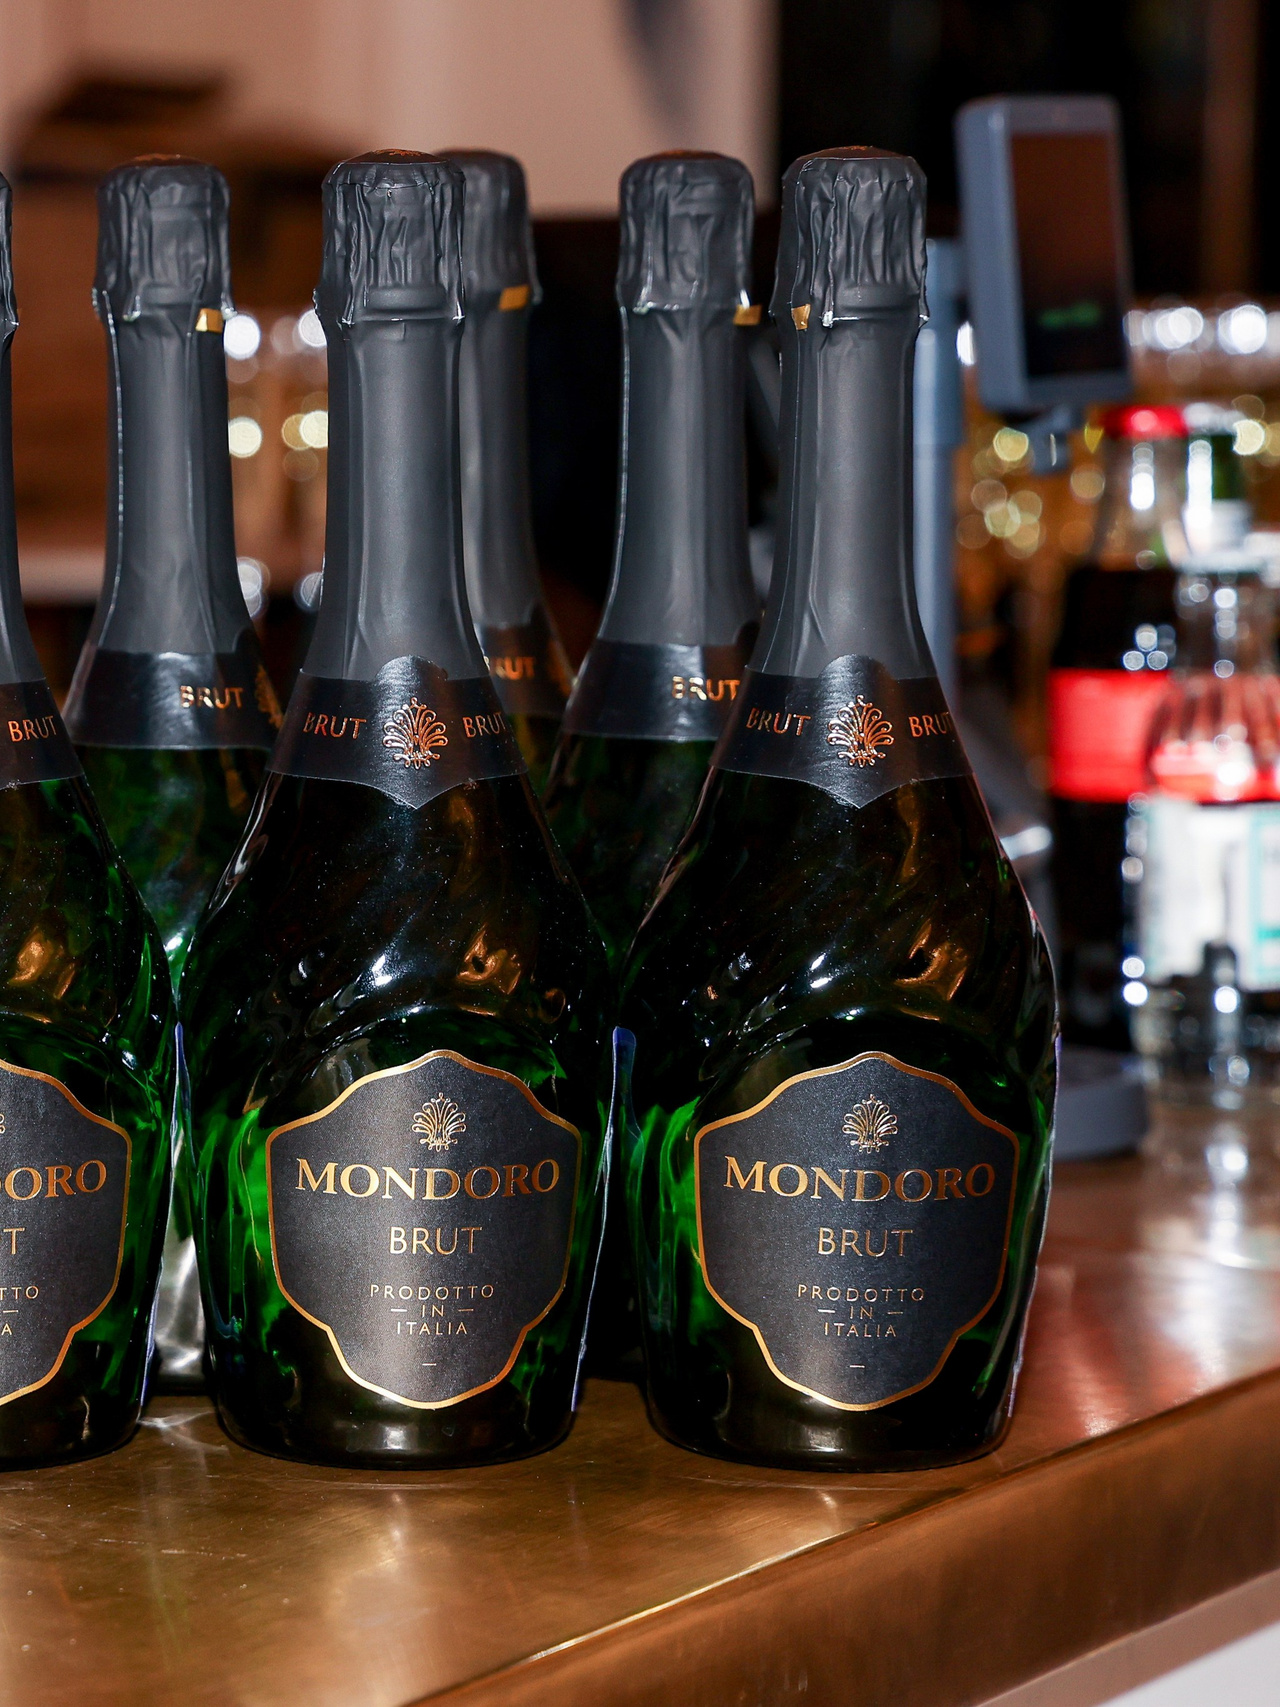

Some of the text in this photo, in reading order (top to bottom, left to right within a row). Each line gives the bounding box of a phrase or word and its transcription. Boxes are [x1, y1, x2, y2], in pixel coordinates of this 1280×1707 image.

[180, 685, 244, 709] BRUT
[672, 676, 741, 701] BRUT
[7, 715, 57, 742] BRUT
[302, 711, 367, 739] BRUT
[746, 707, 811, 736] BRUT
[295, 1158, 560, 1200] MONDORO
[723, 1156, 995, 1202] MONDORO
[389, 1227, 482, 1255] BRUT
[817, 1227, 913, 1257] BRUT
[370, 1284, 495, 1300] PRODOTTO
[797, 1284, 925, 1302] PRODOTTO
[421, 1305, 445, 1318] IN
[849, 1306, 873, 1319] IN
[396, 1321, 467, 1335] ITALIA
[824, 1322, 897, 1337] ITALIA
